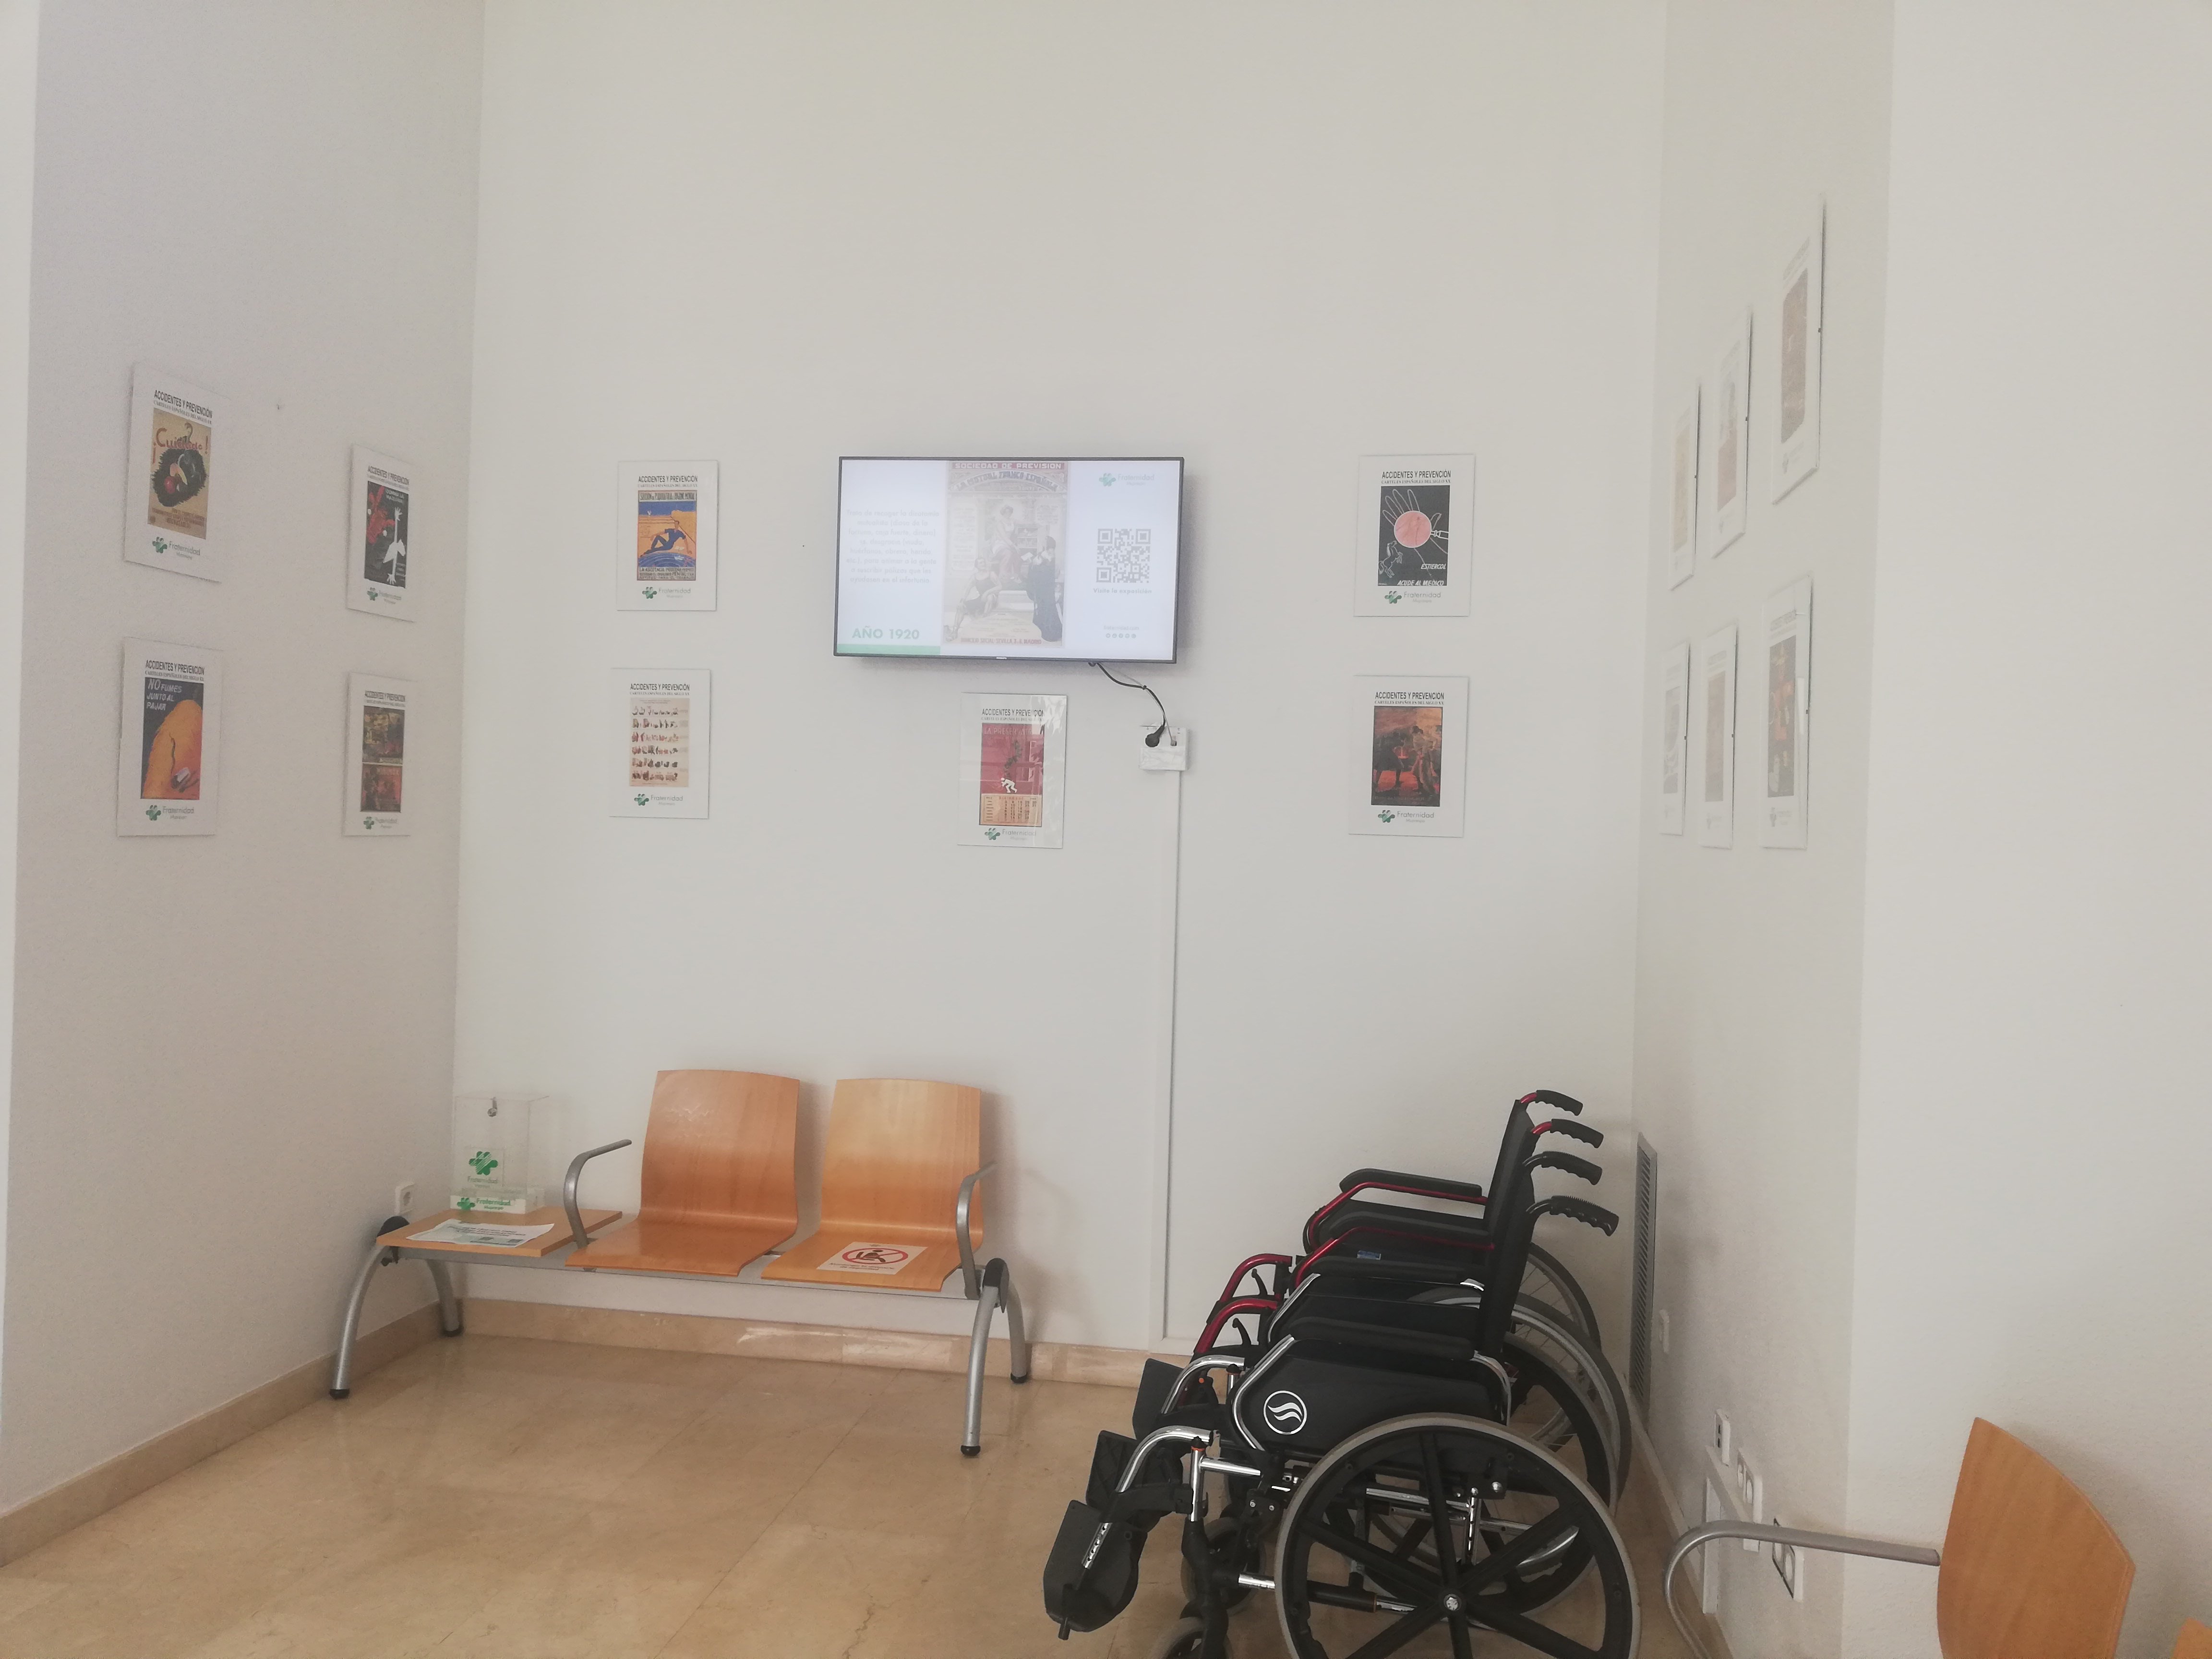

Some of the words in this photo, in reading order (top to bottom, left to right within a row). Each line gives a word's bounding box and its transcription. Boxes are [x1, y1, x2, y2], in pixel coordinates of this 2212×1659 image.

[169, 541, 201, 555] Fraternidad
[852, 625, 883, 639] AÑO
[889, 629, 920, 639] 1920
[148, 678, 161, 690] NO
[161, 684, 182, 693] FUMES
[147, 693, 166, 701] JUNTO
